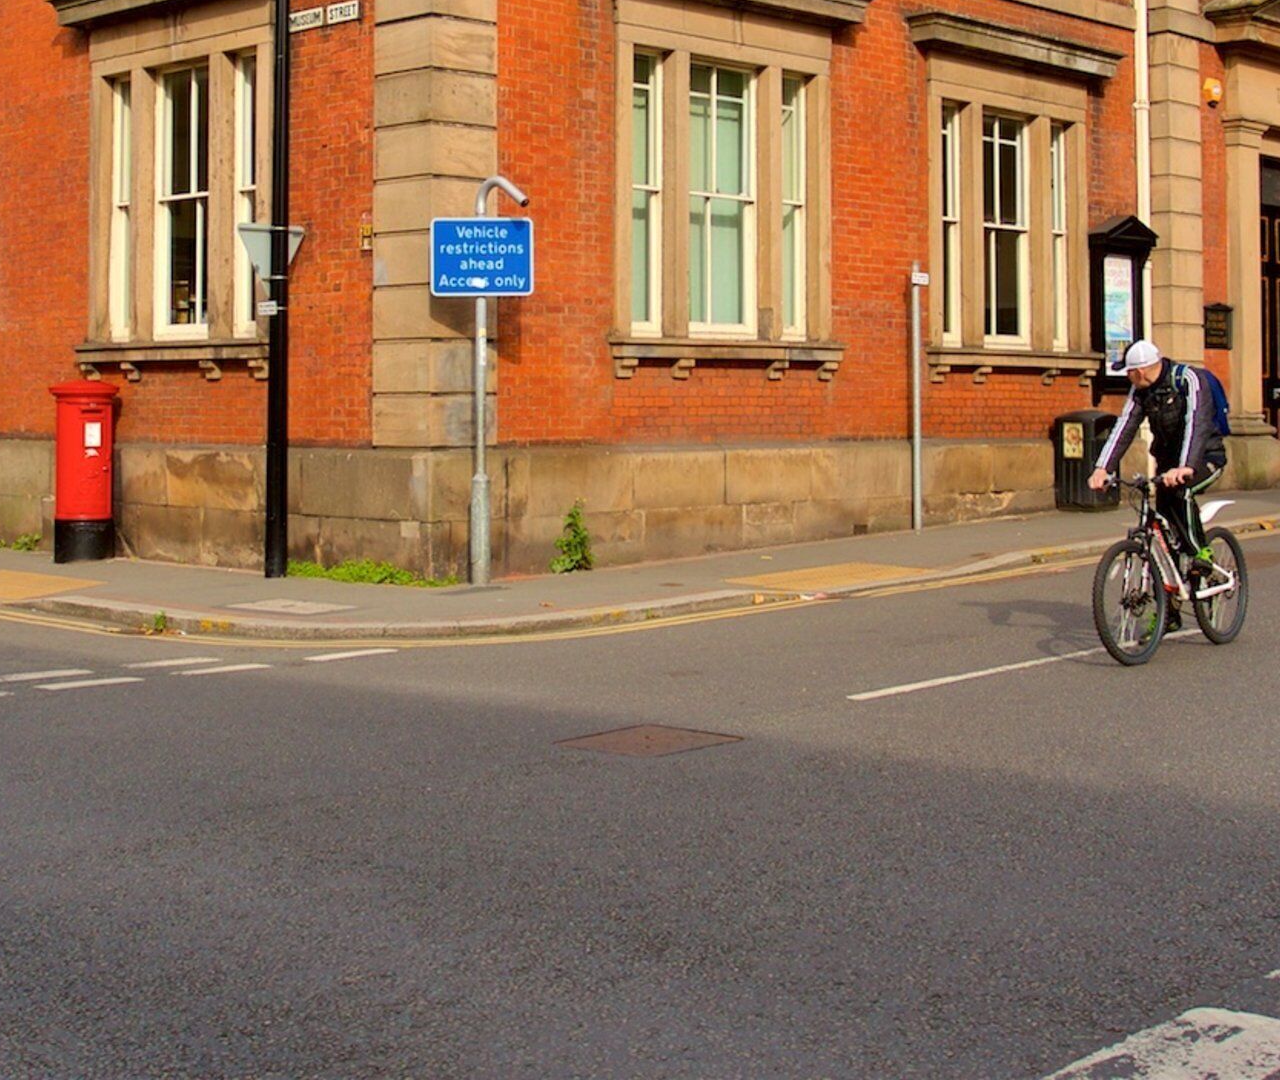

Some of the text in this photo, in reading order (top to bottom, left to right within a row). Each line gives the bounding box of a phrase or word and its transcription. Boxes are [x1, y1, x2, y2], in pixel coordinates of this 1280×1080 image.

[329, 3, 357, 20] STREET
[456, 226, 509, 239] Vehicle
[440, 241, 524, 255] restrictions
[460, 257, 505, 271] ahead
[494, 274, 526, 289] only
